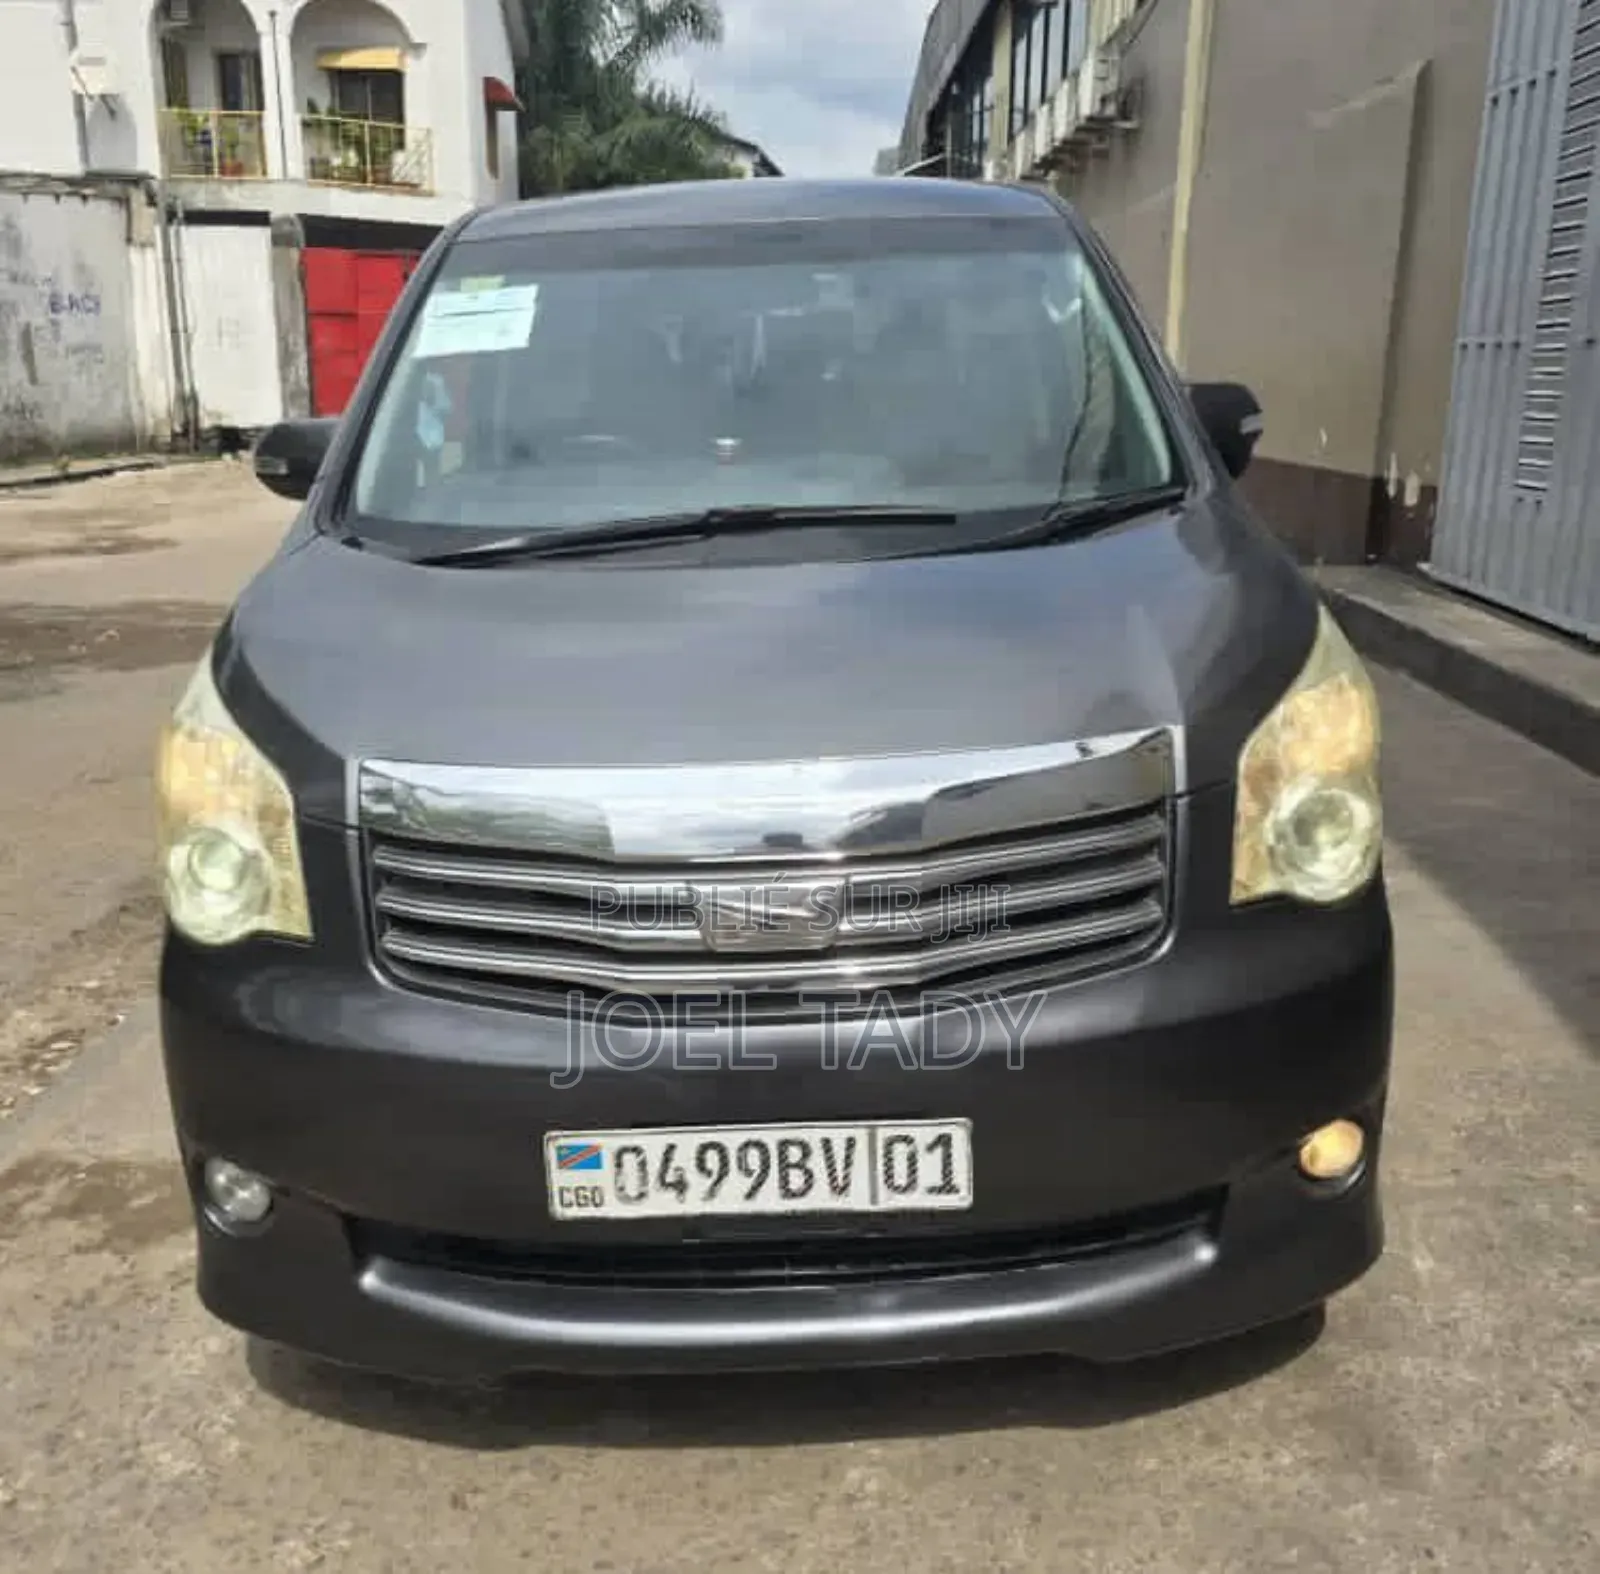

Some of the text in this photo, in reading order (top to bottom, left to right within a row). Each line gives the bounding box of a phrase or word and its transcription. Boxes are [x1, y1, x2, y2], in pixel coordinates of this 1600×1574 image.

[614, 1132, 961, 1203] 0499BV 01
[560, 1186, 605, 1209] CGO
